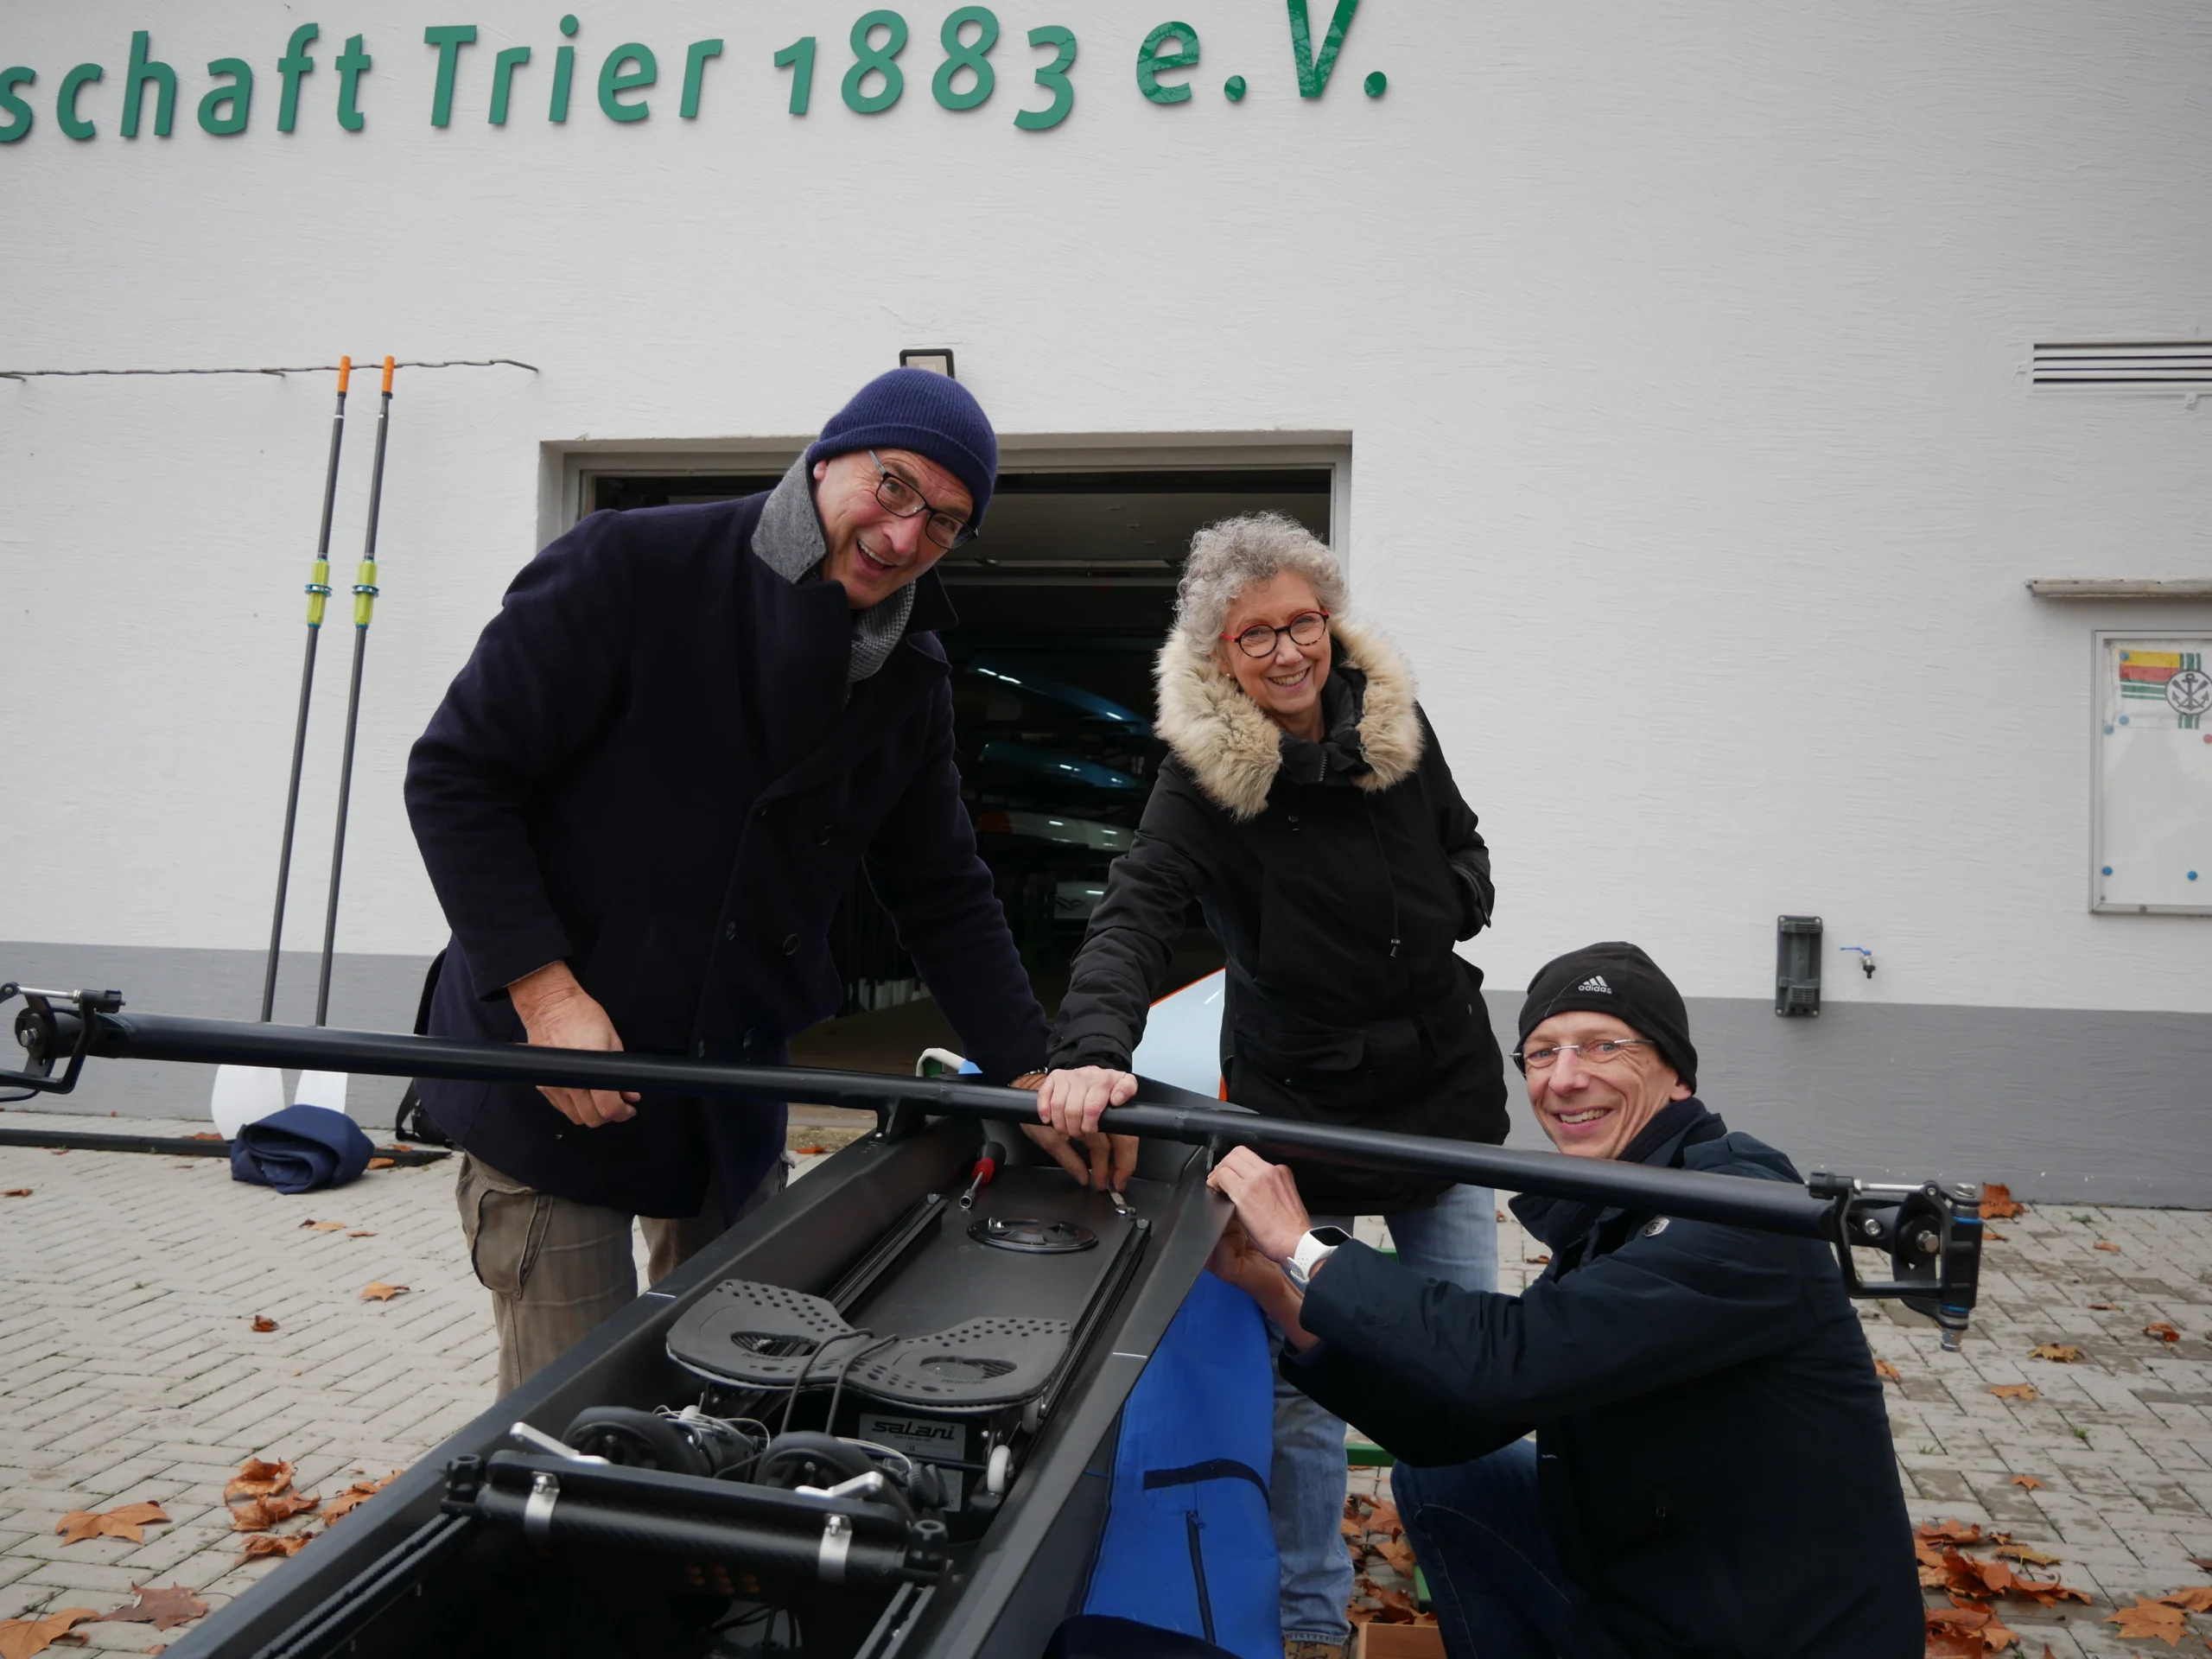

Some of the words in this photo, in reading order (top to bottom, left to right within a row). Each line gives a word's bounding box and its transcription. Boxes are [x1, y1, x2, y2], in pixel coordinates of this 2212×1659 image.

[0, 23, 372, 142] schaft
[425, 15, 724, 126] Trier
[774, 6, 1077, 130] 1883
[1137, 0, 1387, 104] e.V.
[1578, 984, 1612, 995] adidas
